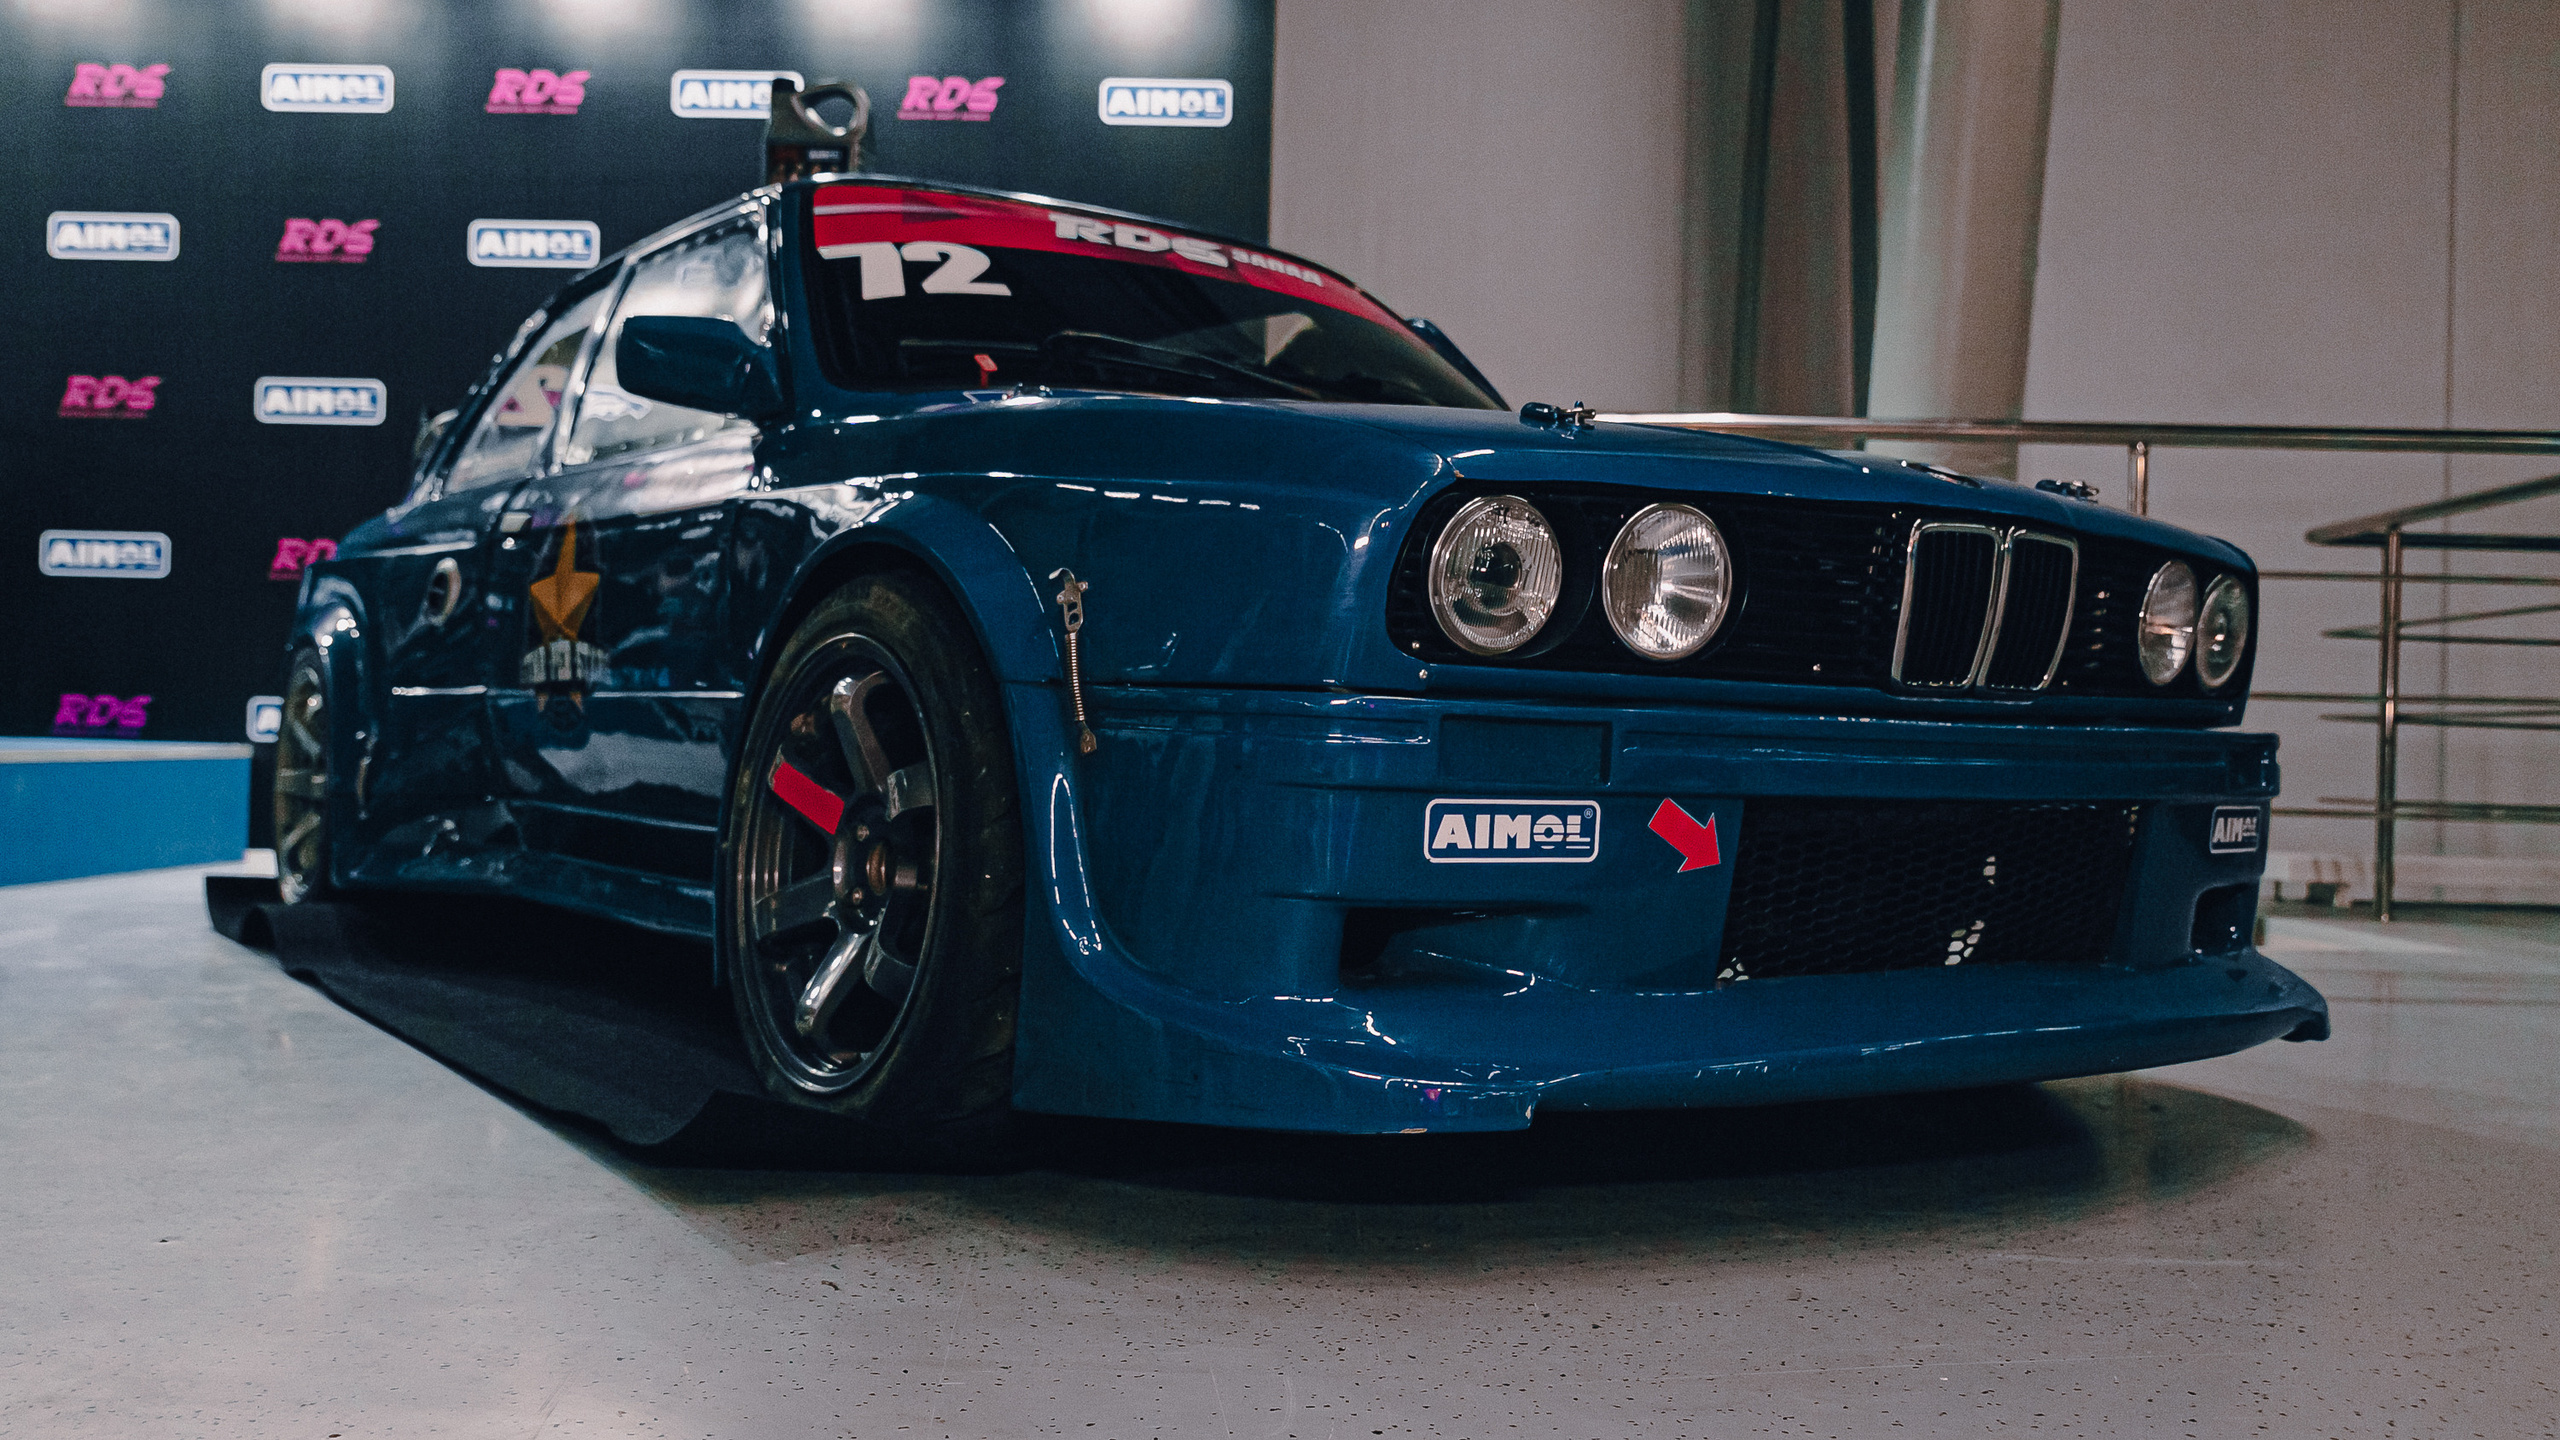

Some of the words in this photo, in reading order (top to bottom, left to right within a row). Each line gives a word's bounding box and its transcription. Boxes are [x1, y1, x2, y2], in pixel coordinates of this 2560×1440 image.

[70, 63, 171, 98] RDS
[489, 69, 591, 105] RDS
[680, 81, 772, 109] AIMO
[902, 76, 1005, 112] RDS
[1108, 88, 1225, 117] AIMOL
[279, 218, 380, 254] RDS
[1049, 212, 1229, 268] RDS
[817, 242, 1011, 300] 12
[62, 375, 161, 411] RDS
[54, 694, 151, 729] RDS
[1431, 814, 1591, 849] AIMOL
